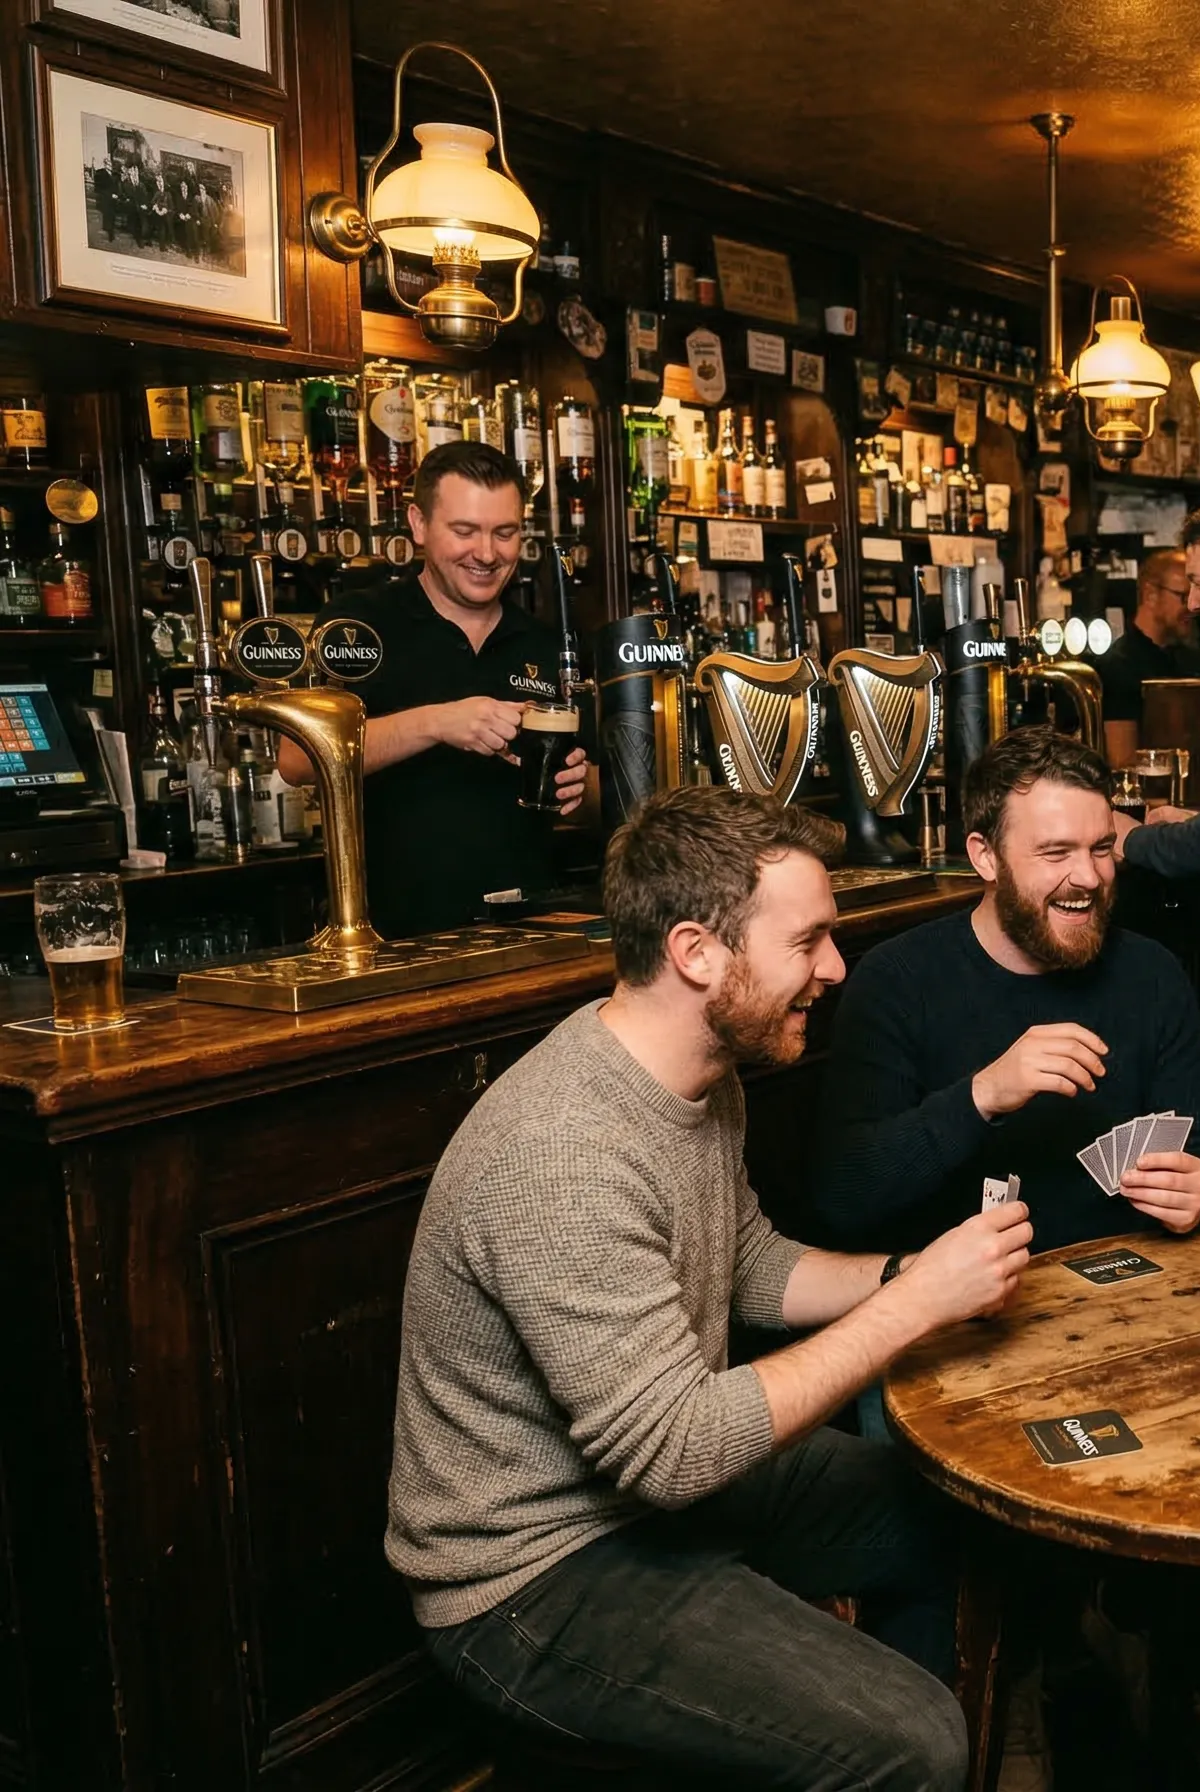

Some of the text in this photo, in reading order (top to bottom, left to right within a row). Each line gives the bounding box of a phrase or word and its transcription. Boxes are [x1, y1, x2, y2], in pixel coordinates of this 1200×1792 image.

[243, 644, 302, 660] GUINNESS
[324, 644, 378, 660] GUINNESS
[849, 729, 879, 798] GUINNESS
